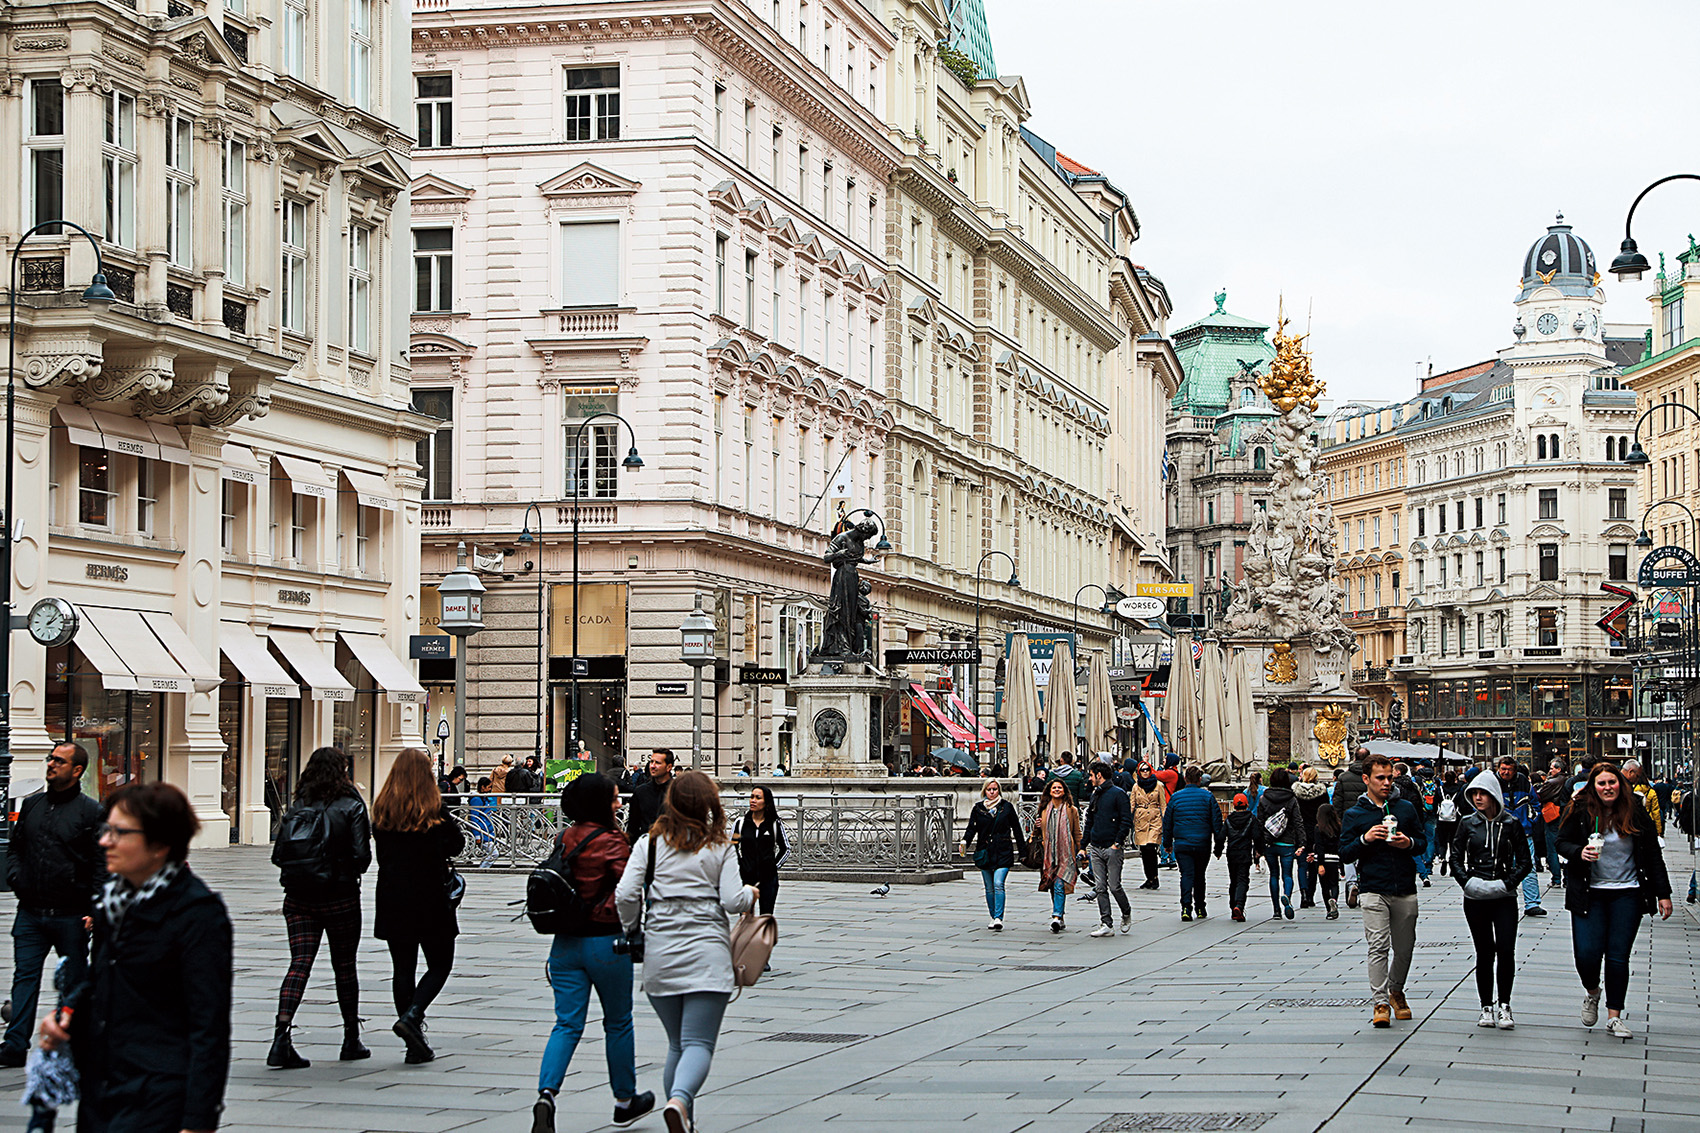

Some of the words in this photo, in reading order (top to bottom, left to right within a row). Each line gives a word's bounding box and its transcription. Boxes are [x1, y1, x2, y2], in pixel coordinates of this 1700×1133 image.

[1653, 570, 1688, 579] BUFFET
[1142, 586, 1188, 594] VERSACE
[564, 615, 612, 625] ECADA
[1027, 638, 1057, 646] ener
[906, 650, 977, 660] AVANTGARDE
[743, 671, 782, 680] ESCADA
[1086, 669, 1125, 677] HNER
[1110, 682, 1131, 691] atch
[641, 754, 681, 762] ESA
